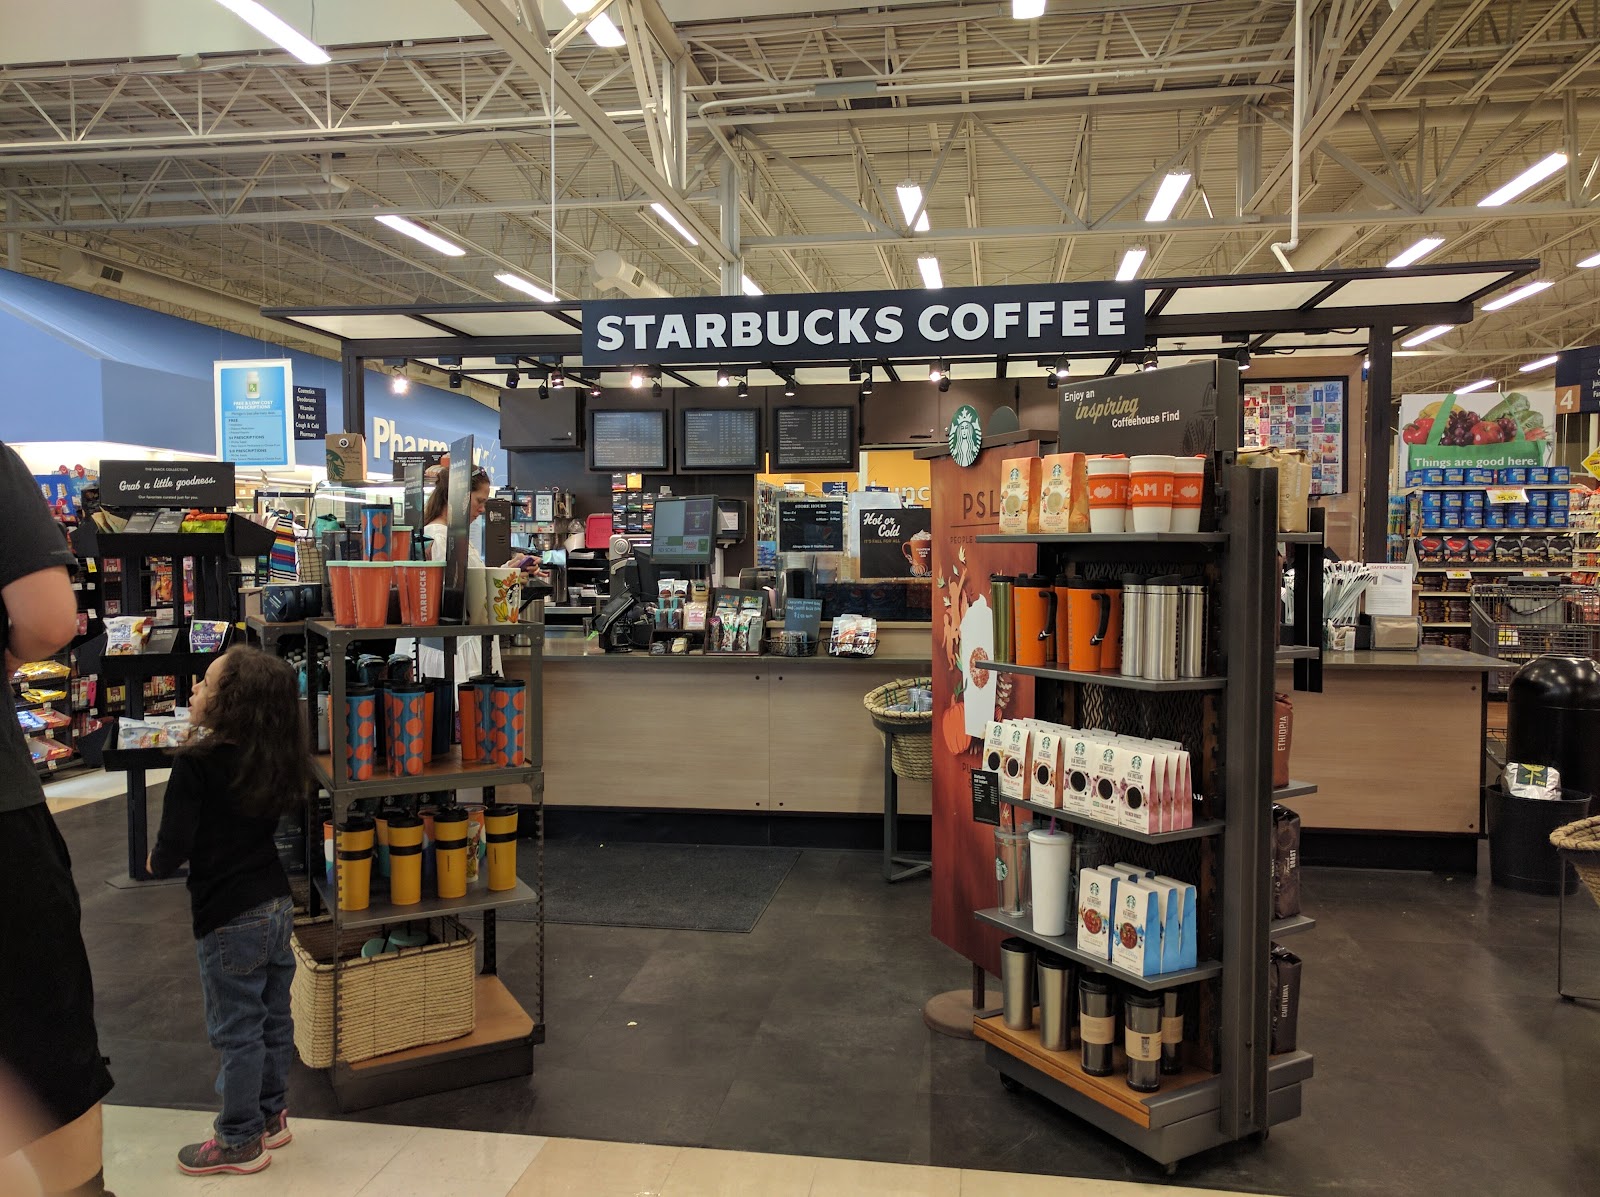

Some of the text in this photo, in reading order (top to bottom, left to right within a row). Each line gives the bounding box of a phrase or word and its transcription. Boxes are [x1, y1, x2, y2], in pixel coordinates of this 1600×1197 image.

[596, 298, 1127, 351] STARBUCKS COFFEE
[297, 387, 315, 395] Cosmetics
[1064, 390, 1095, 403] Enjoy an
[296, 396, 317, 404] Deodorants
[1560, 389, 1573, 410] 4
[1075, 395, 1139, 424] inspiring
[1111, 410, 1180, 428] Coffeehouse Find
[299, 430, 317, 438] Pharmacy
[1413, 457, 1452, 468] Things
[1454, 459, 1473, 467] are
[1475, 457, 1505, 468] good
[119, 480, 141, 492] Grab
[153, 477, 174, 489] little
[176, 475, 216, 491] goodness.
[963, 490, 999, 520] PSL
[863, 512, 895, 525] Hot or
[878, 524, 901, 537] Cold
[950, 535, 973, 544] PEOPLE
[419, 569, 428, 623] STARBUCKS
[1277, 715, 1288, 752] ETHIOPIA
